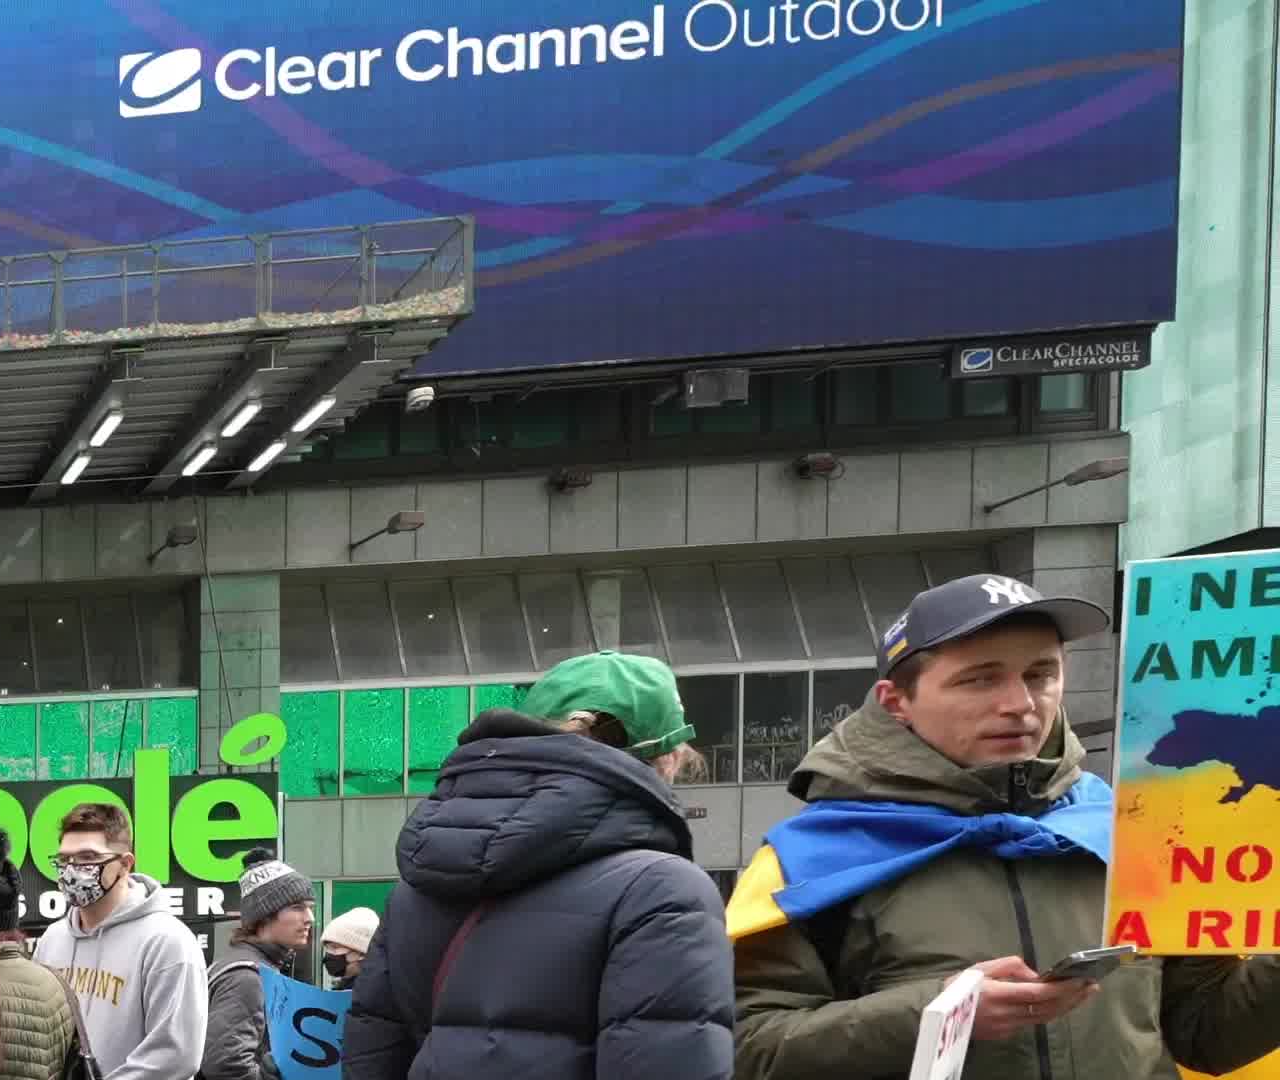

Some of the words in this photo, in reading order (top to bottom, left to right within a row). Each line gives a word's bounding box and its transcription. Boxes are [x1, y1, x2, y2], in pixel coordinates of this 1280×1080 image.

[215, 44, 382, 101] Clear
[395, 5, 665, 82] Channel
[1054, 354, 1139, 368] SPECTACOLOR
[1135, 576, 1152, 616] I
[1132, 634, 1280, 683] AM
[1109, 910, 1152, 948] A
[1186, 909, 1280, 949] RI
